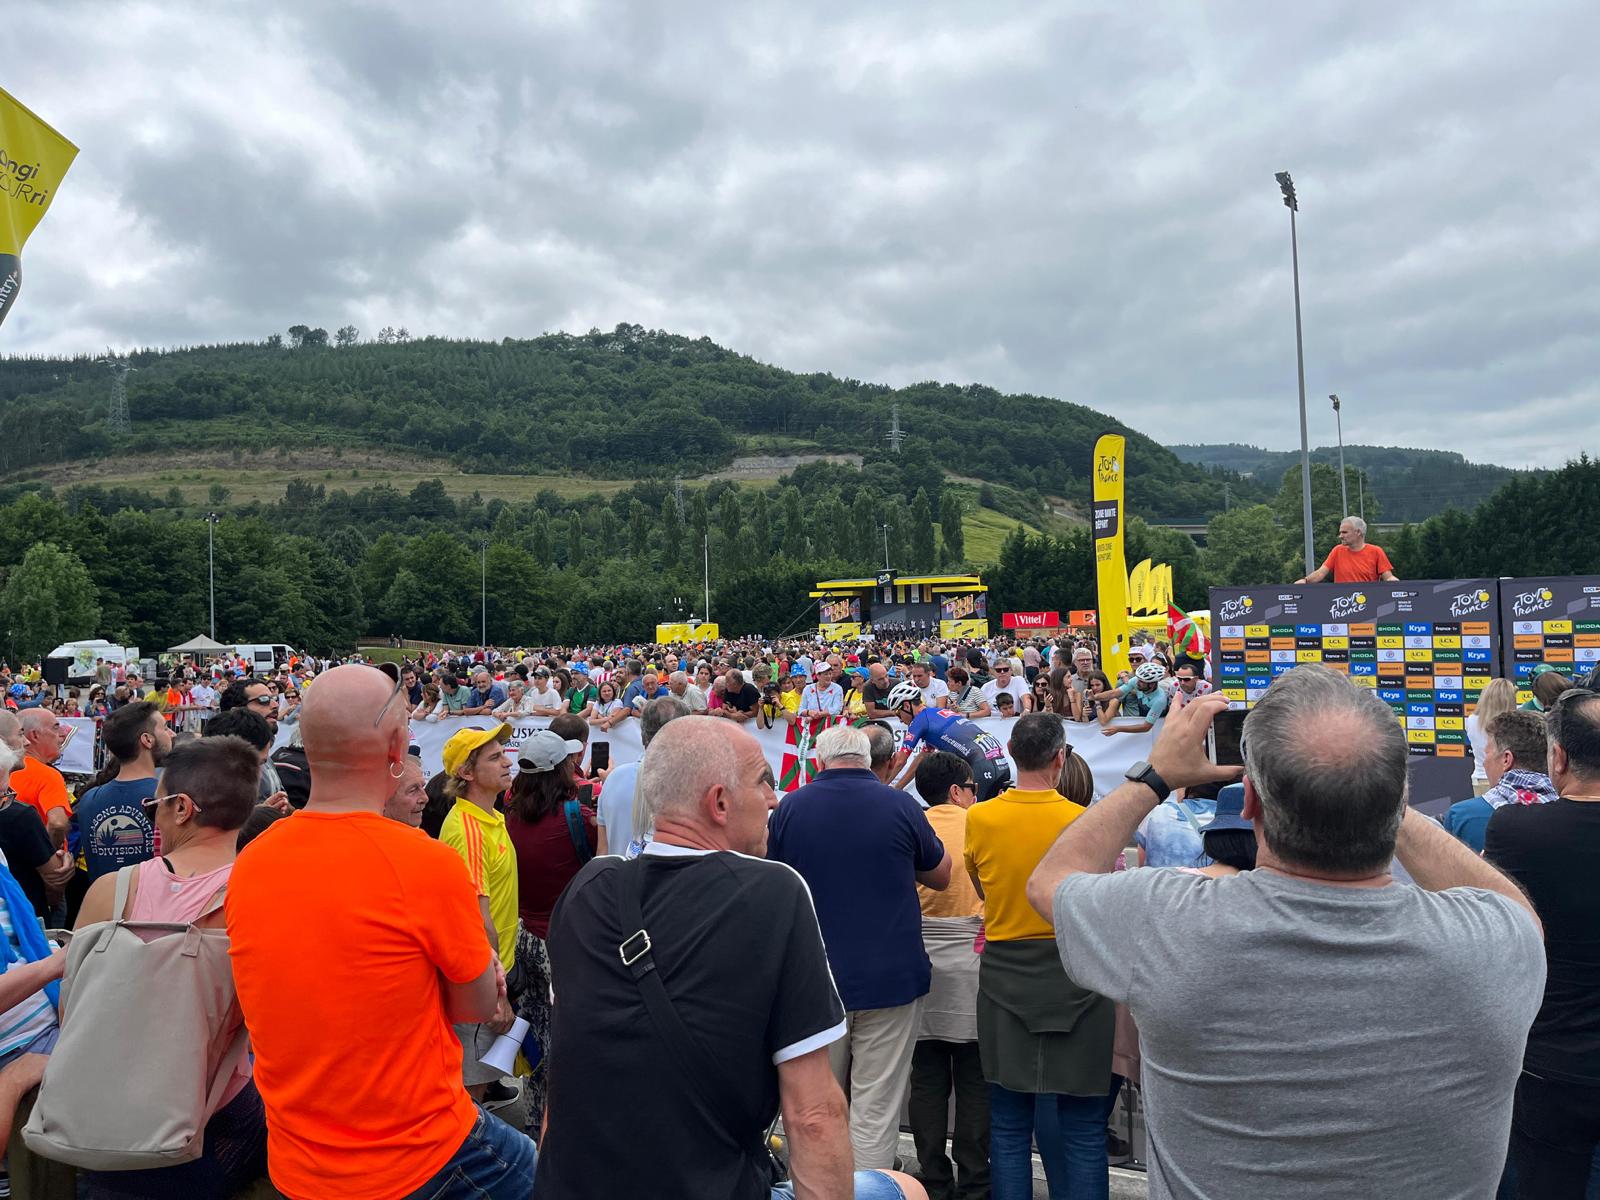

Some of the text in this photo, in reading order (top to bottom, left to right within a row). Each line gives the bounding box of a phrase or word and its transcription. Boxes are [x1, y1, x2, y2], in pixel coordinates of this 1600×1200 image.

[1019, 615, 1041, 624] Vittel
[1300, 626, 1316, 634] Krys
[1467, 651, 1486, 659] Krys
[1354, 665, 1371, 673] Krys
[119, 805, 155, 853] ADVENTURE
[98, 846, 143, 856] DIVISION
